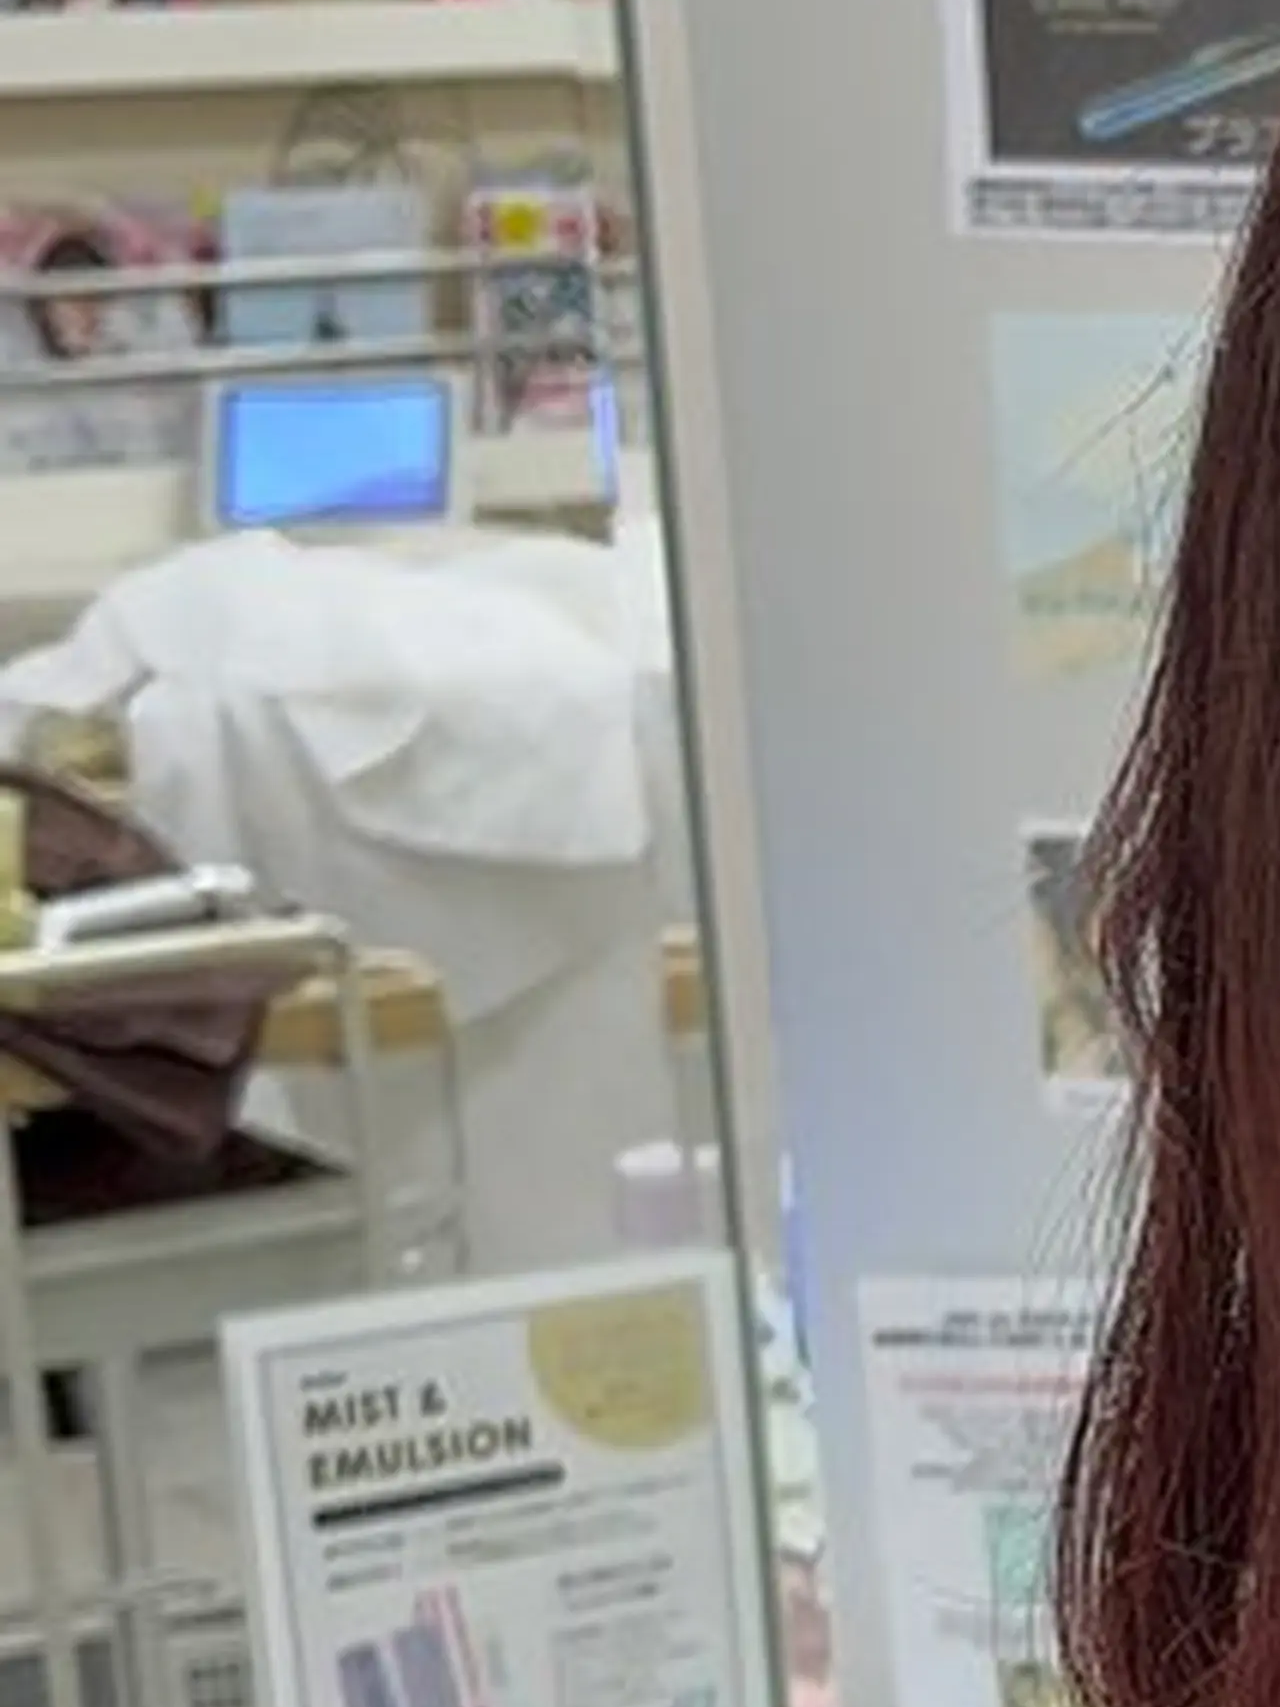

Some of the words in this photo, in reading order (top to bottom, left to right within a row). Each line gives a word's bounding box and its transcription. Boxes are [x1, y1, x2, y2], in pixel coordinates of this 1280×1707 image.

[305, 1384, 398, 1436] MIST
[420, 1378, 447, 1418] &
[308, 1415, 533, 1488] EMULSION
